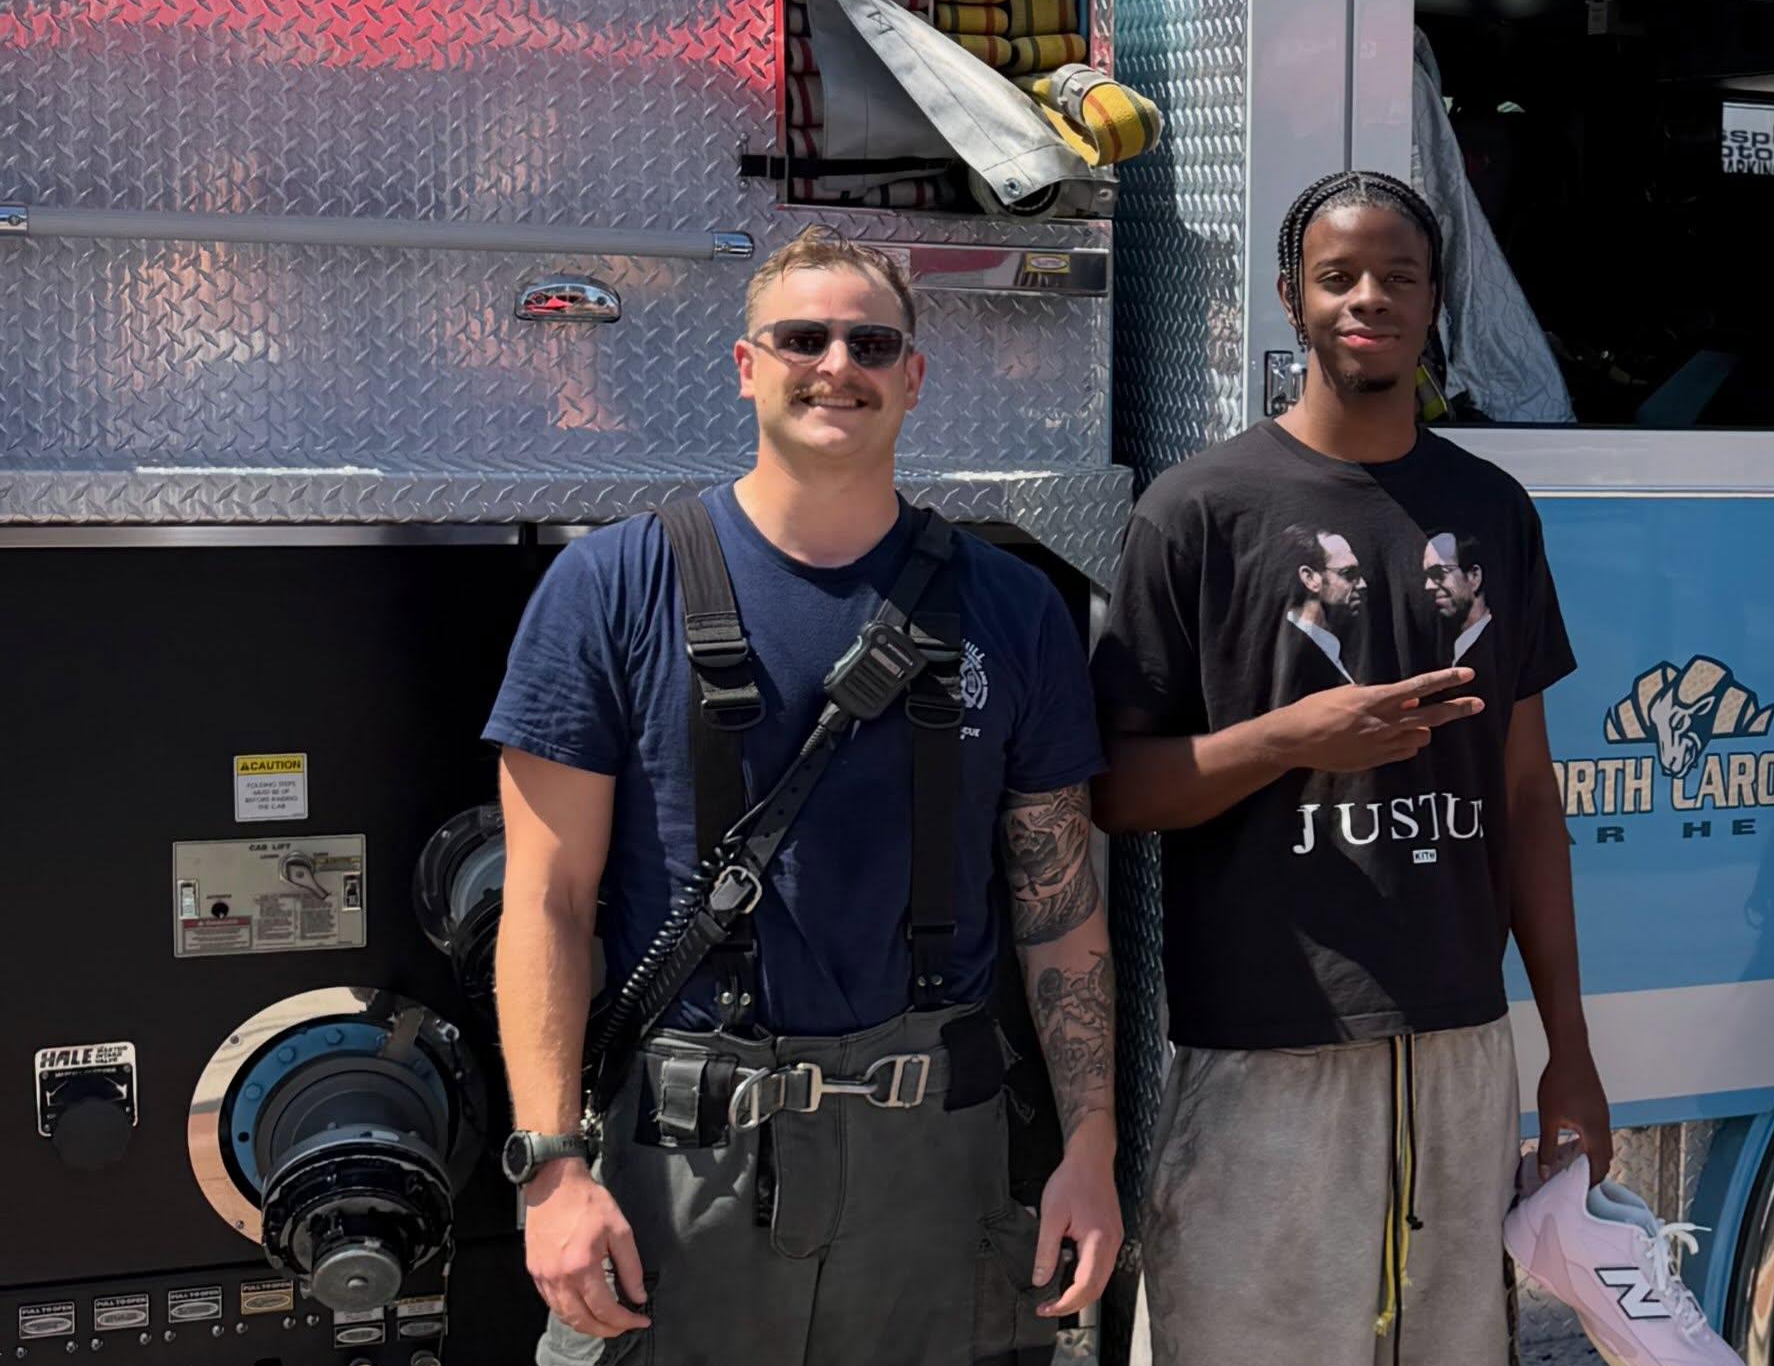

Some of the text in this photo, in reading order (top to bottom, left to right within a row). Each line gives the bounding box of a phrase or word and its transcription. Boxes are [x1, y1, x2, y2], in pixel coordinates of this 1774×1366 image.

[250, 760, 301, 771] CAUTION
[1292, 791, 1484, 855] JUSTU
[272, 843, 292, 851] LIFT
[1414, 850, 1436, 862] KITH
[40, 1046, 94, 1069] HALE
